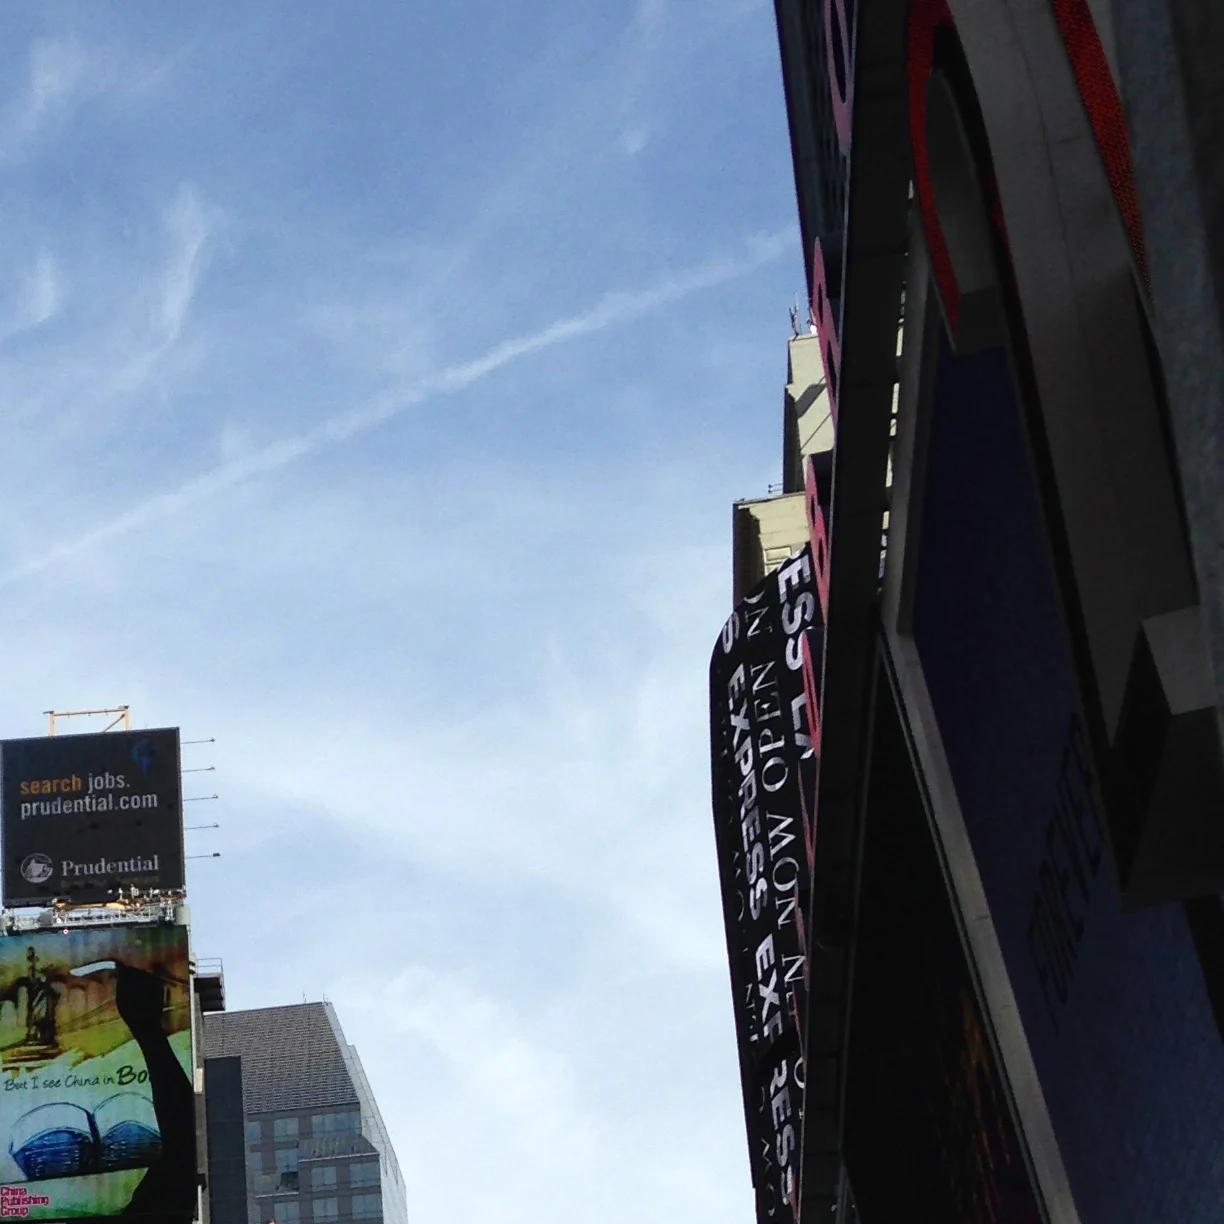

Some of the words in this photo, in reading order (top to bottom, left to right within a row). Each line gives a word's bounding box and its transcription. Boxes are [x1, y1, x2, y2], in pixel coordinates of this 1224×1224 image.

[20, 774, 82, 795] search
[88, 772, 130, 793] jobs.
[21, 793, 158, 820] prudential.com
[61, 855, 159, 876] Prudential
[42, 1079, 62, 1089] see
[65, 1075, 101, 1087] China
[102, 1077, 114, 1085] in
[0, 1187, 27, 1196] China
[0, 1195, 50, 1207] Publishing
[0, 1206, 29, 1218] Group
